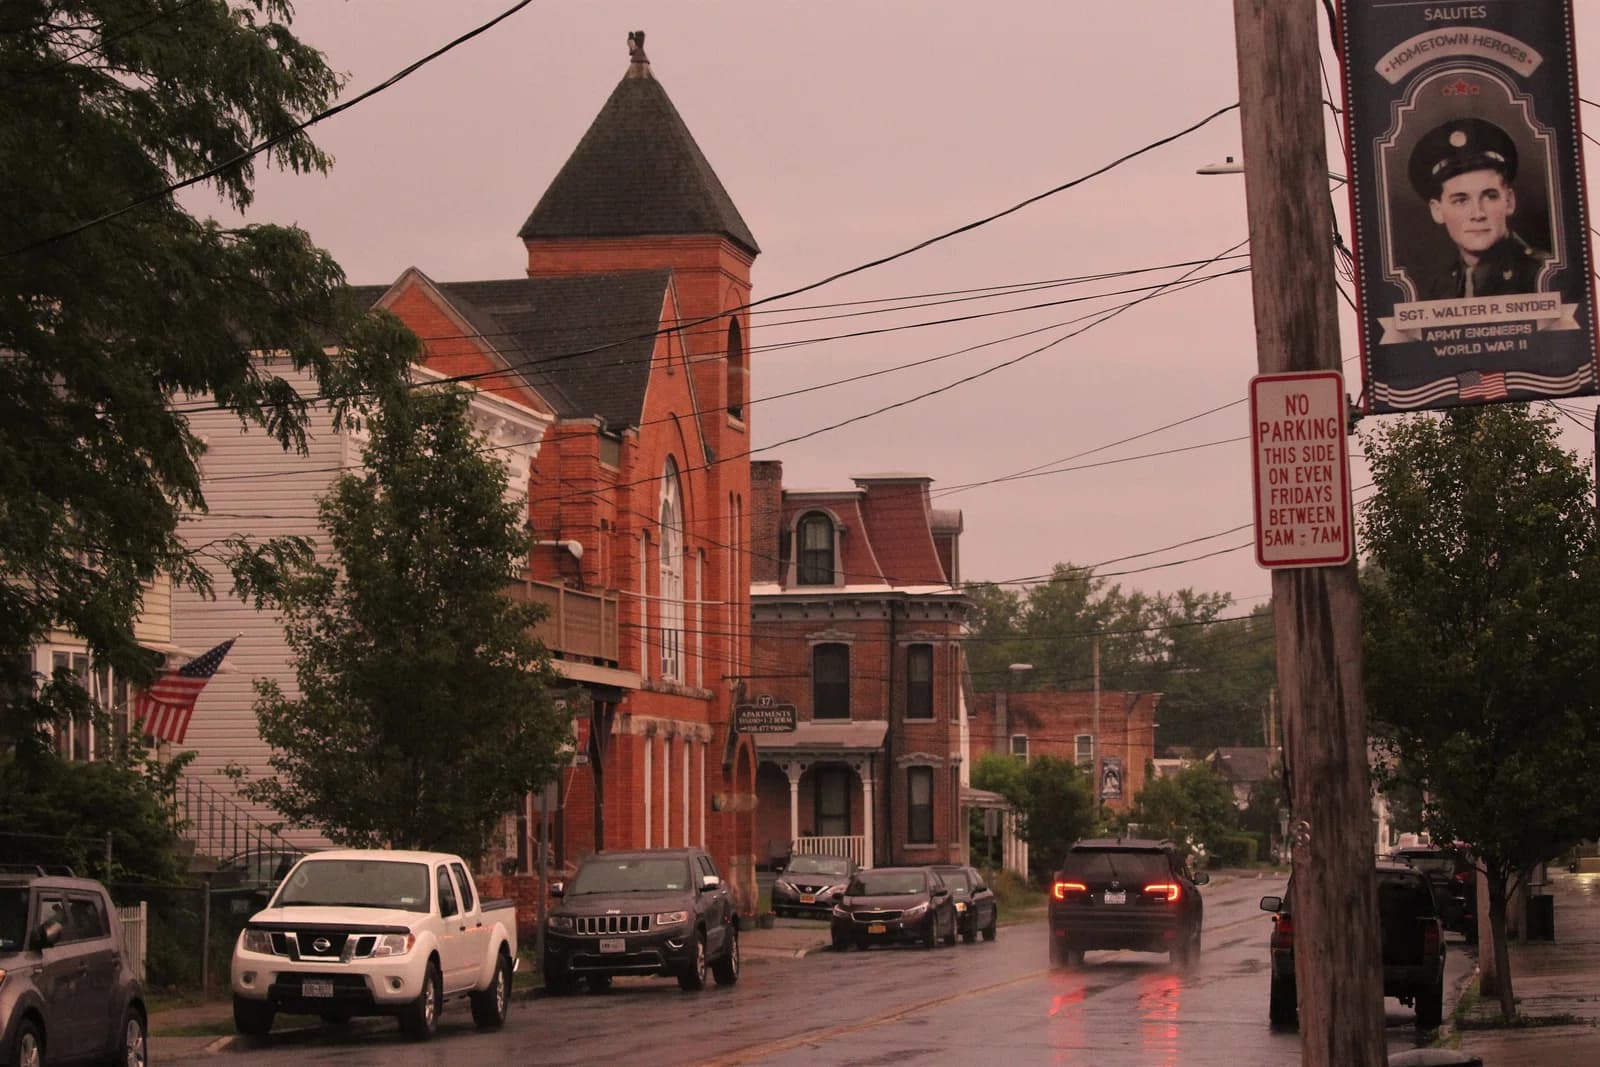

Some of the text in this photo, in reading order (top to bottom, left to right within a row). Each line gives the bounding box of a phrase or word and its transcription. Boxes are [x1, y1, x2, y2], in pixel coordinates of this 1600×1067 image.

[1424, 5, 1487, 21] SALUTES
[1389, 33, 1528, 71] HOMETOWN HEROES
[1399, 300, 1557, 322] SGT. WALTER R. SNYDER
[1426, 323, 1532, 342] ARMY ENGINEERS
[1433, 340, 1527, 357] WORLD WAR II
[1285, 394, 1309, 417] NO
[1259, 418, 1337, 443] PARKING
[1264, 444, 1336, 465] THIS SIDE
[1269, 465, 1332, 485] ON EVEN
[1271, 486, 1332, 505] FRIDAYS
[1269, 506, 1335, 526] BETWEEN
[1264, 529, 1294, 547] 5AM
[1311, 525, 1342, 545] 7AM
